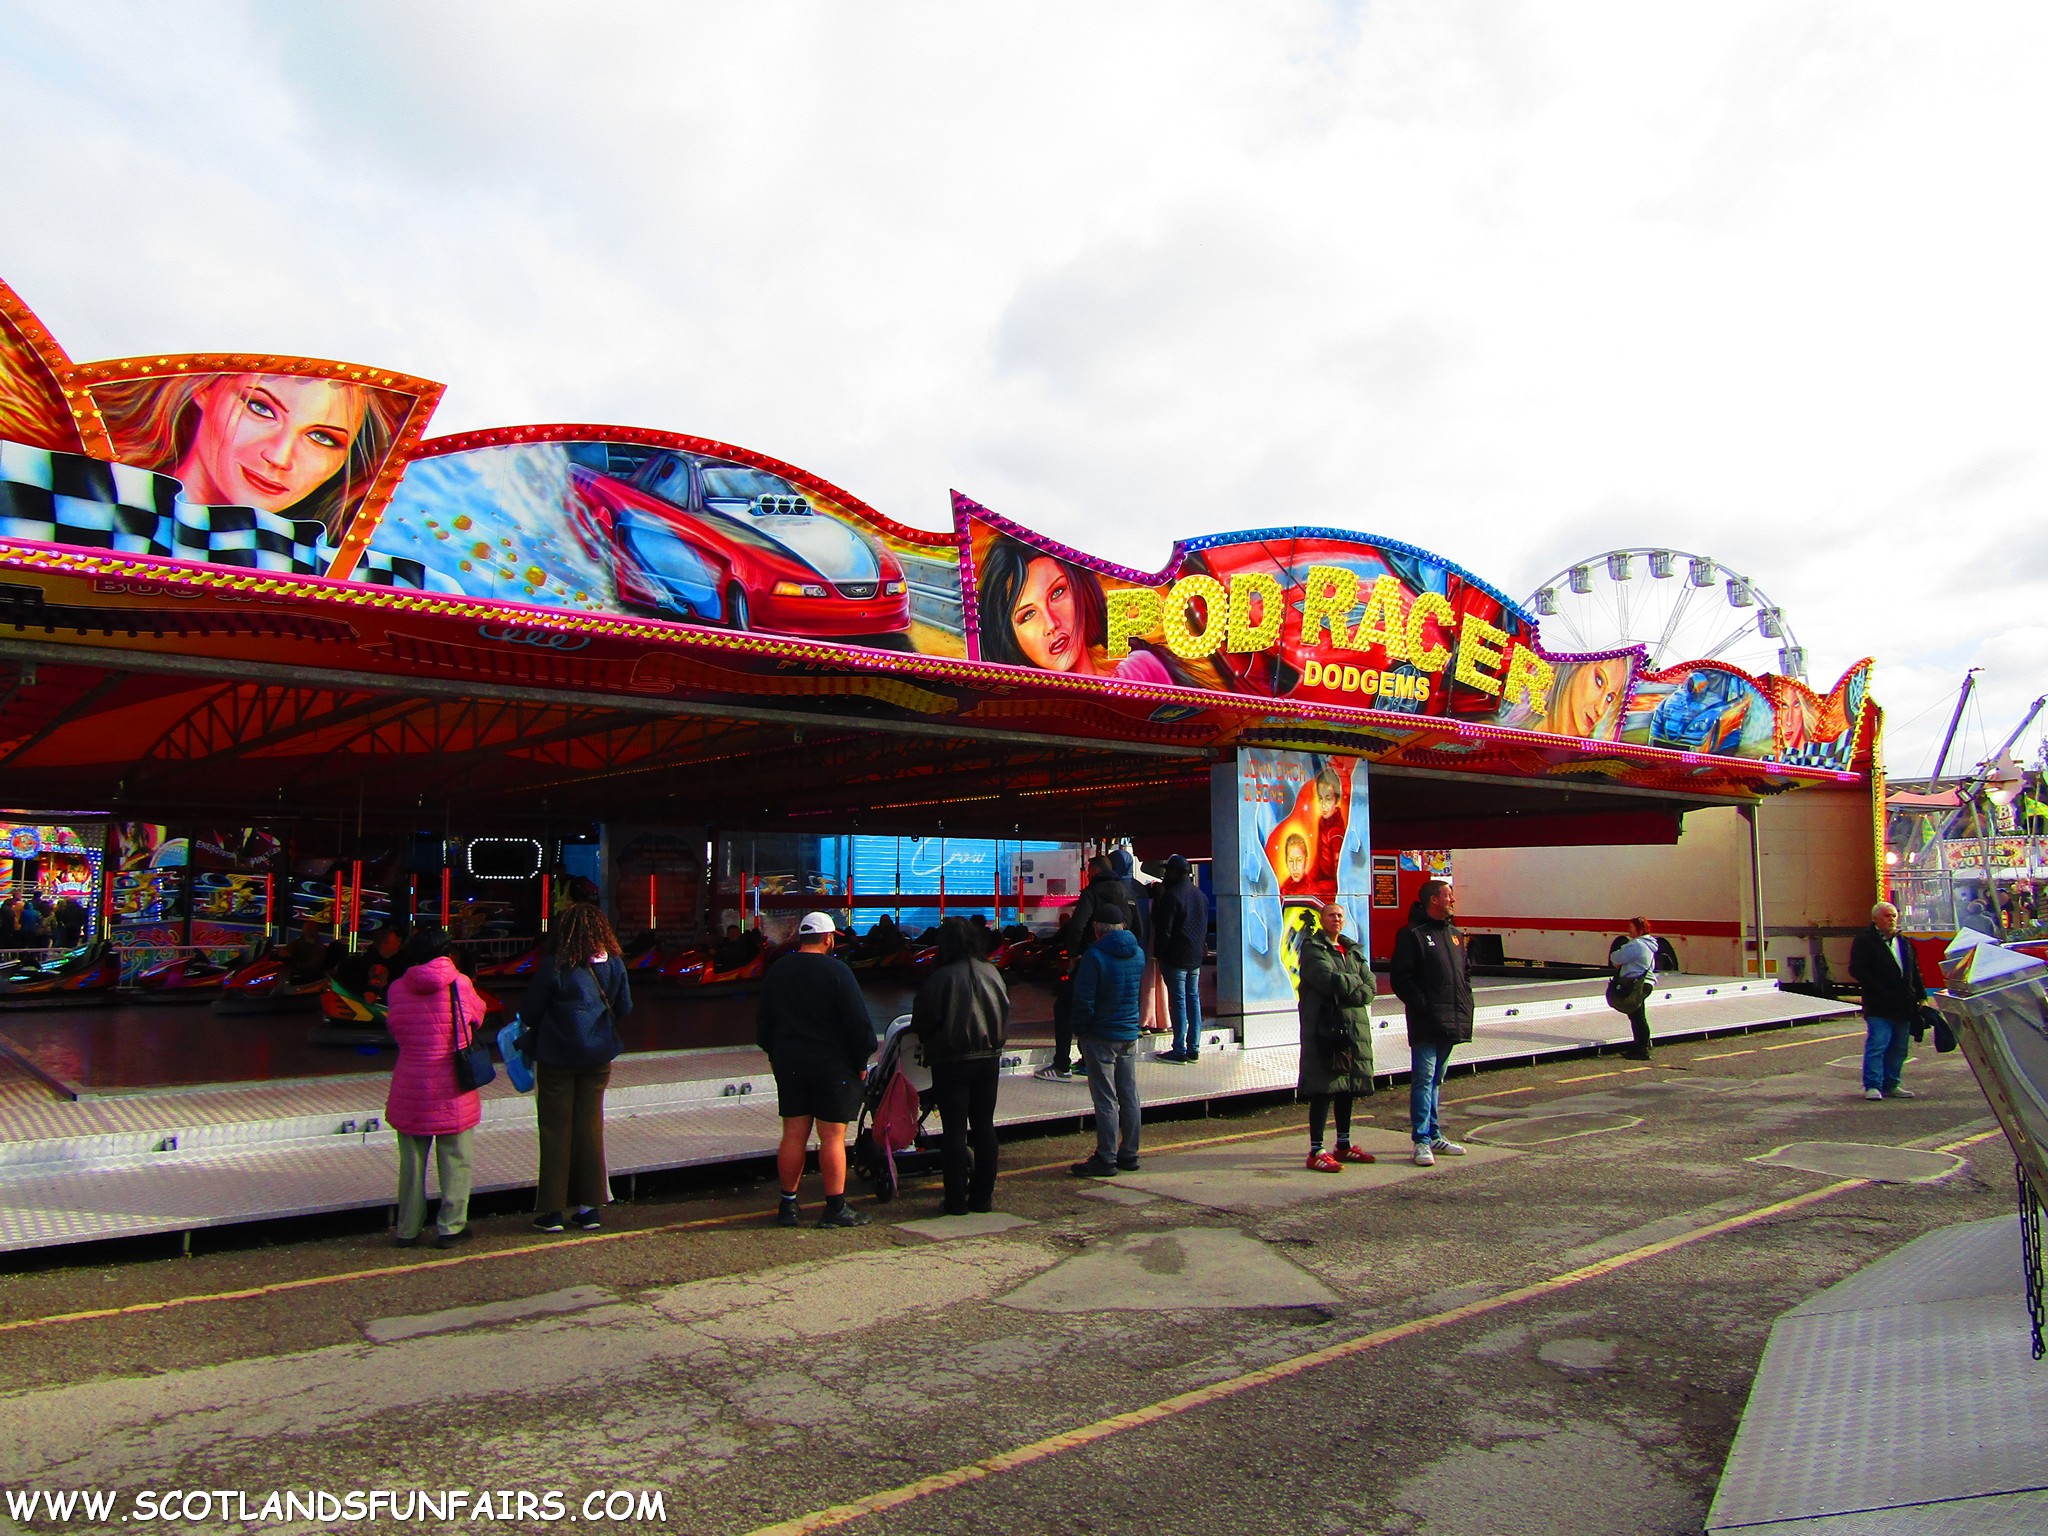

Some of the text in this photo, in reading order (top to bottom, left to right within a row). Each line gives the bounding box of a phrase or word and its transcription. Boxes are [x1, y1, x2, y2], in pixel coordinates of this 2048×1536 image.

[1106, 564, 1555, 717] POD RACER
[1303, 659, 1431, 702] DODGEMS
[1255, 782, 1285, 805] SONS
[911, 838, 987, 877] Crow
